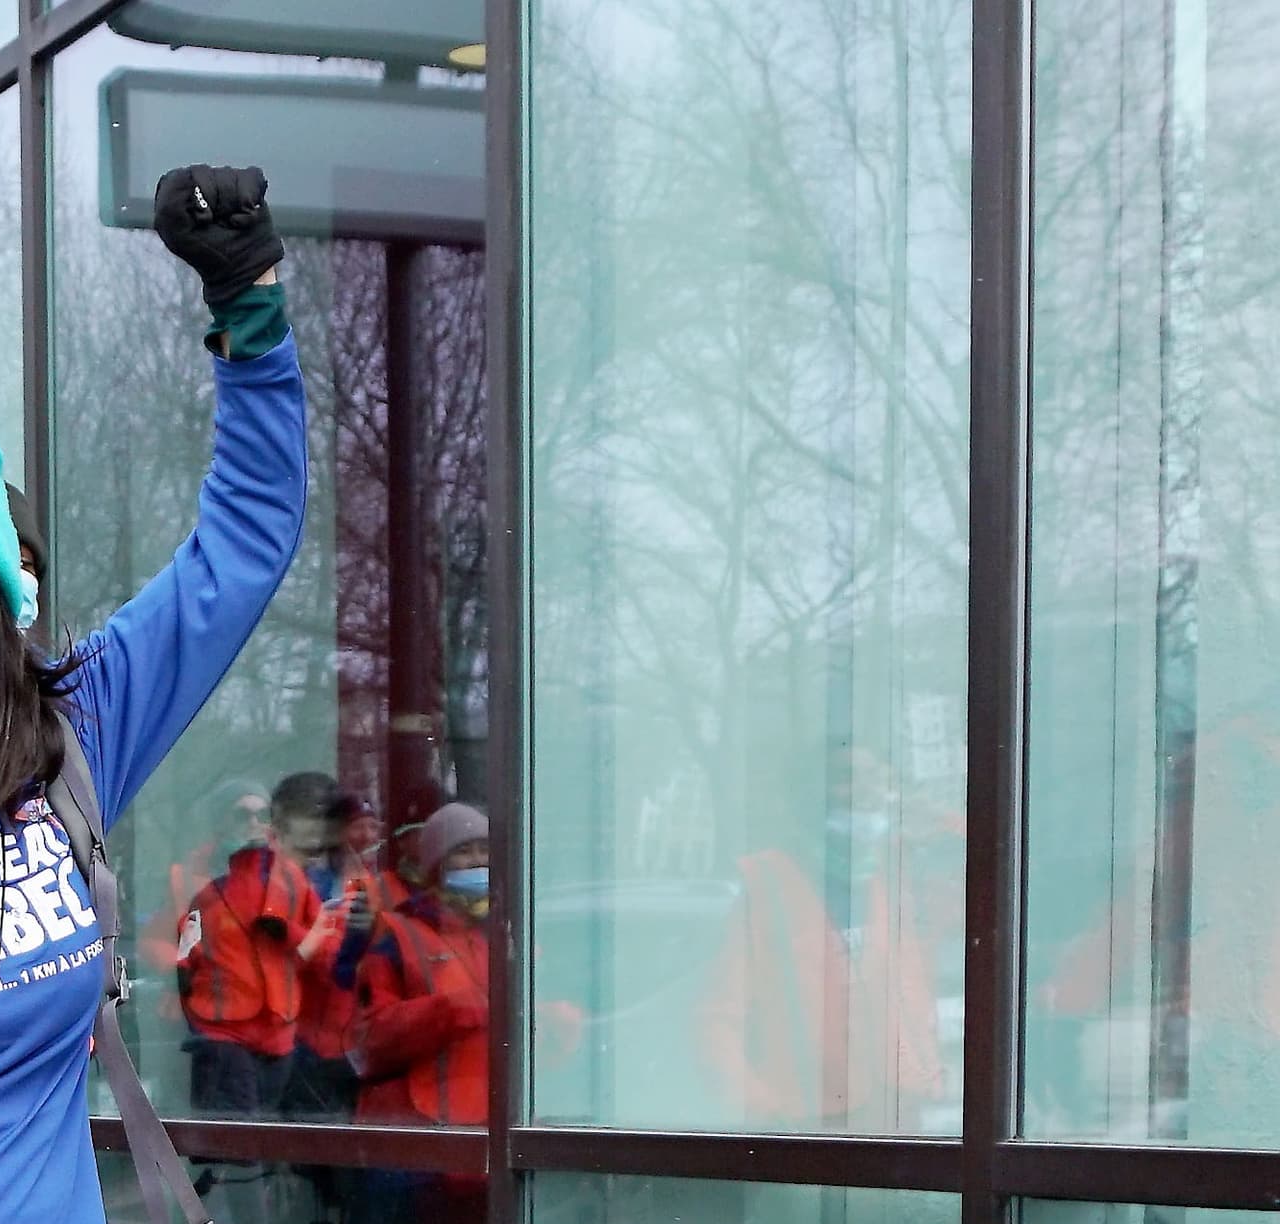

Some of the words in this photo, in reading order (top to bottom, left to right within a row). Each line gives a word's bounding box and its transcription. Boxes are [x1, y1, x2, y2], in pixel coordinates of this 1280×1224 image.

[20, 969, 31, 984] 1
[32, 961, 58, 981] KM
[69, 950, 88, 968] LA
